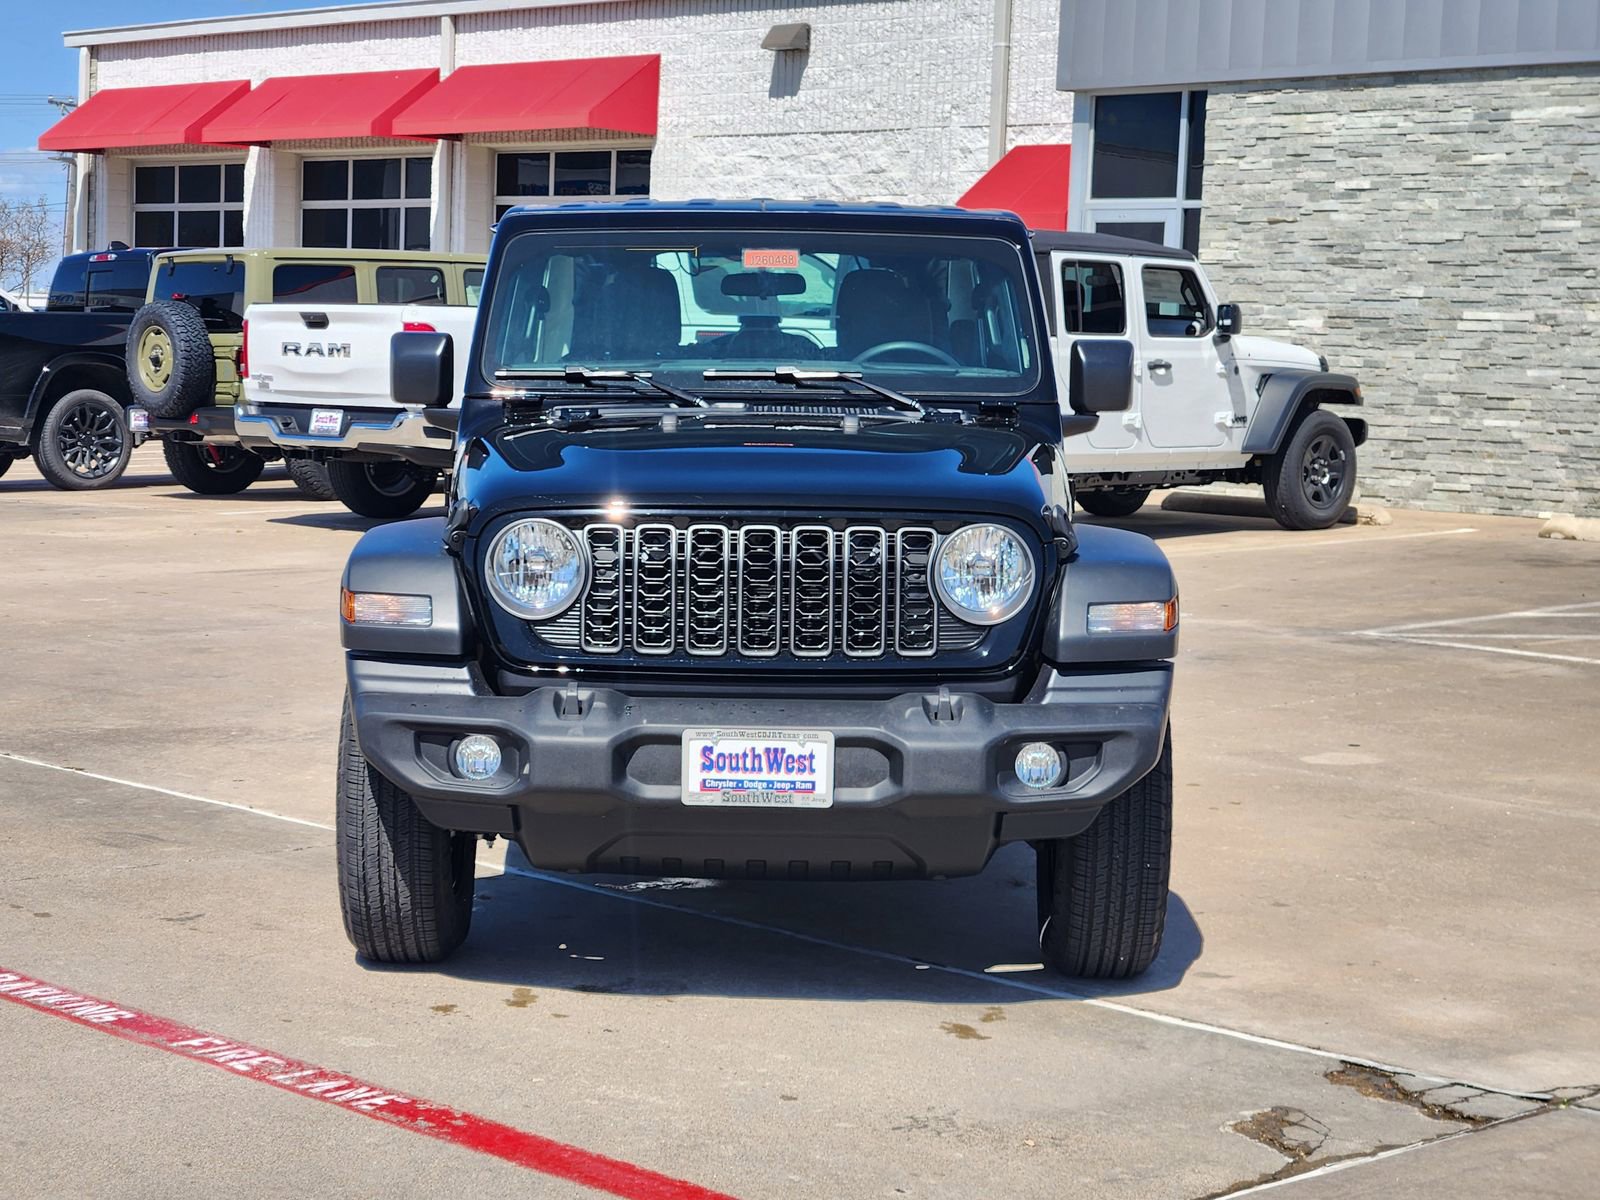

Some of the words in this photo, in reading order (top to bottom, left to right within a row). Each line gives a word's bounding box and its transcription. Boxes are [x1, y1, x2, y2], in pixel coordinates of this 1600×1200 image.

[281, 341, 351, 358] RAM
[701, 745, 816, 775] SouthWest
[705, 779, 737, 789] Chrysler
[743, 781, 767, 790] Dodge
[773, 781, 791, 790] Jeep
[795, 781, 813, 789] Ram
[722, 791, 793, 803] SouthWest
[169, 1036, 288, 1071] FIRE
[269, 1069, 412, 1110] LANE
